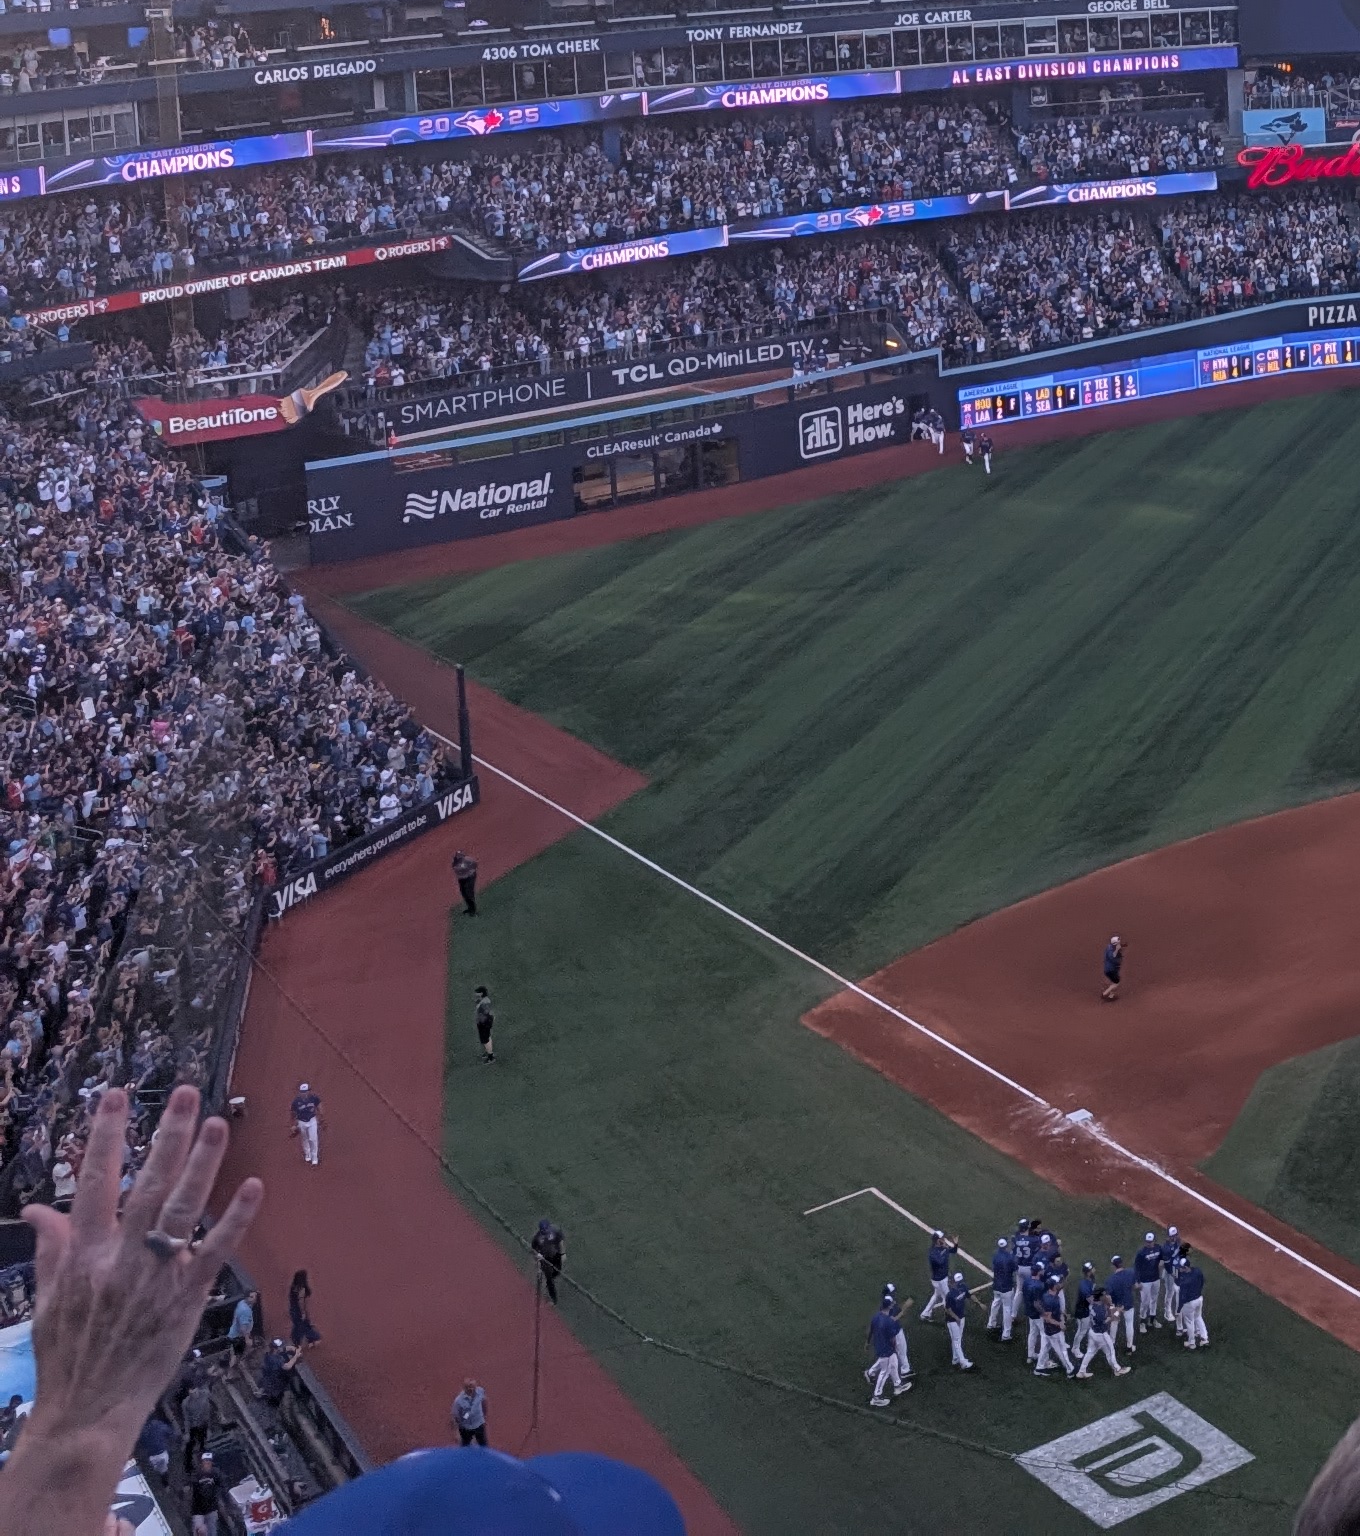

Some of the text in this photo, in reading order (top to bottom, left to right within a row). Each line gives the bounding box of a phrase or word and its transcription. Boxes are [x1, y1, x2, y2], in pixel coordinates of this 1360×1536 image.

[894, 10, 972, 27] JOE CARTER
[1087, 0, 1139, 14] GEORGE
[686, 21, 803, 43] TONY FERNANDEZ
[482, 38, 600, 61] 4306 TOM CHEEK
[254, 60, 377, 85] CARLOS DELGADO
[952, 53, 1180, 86] AL EAST DIVISION CHAMPIONS
[721, 83, 829, 109] CHAMPIONS
[122, 148, 234, 182] CHAMPIONS
[1067, 181, 1158, 203] CHAMPIONS
[581, 241, 669, 271] CHAMPIONS
[140, 242, 431, 305] PROUD OWNER OF CANADA'S TEAM ROGERS
[37, 303, 89, 325] ROGERS
[1308, 303, 1357, 327] PIZZA
[401, 377, 567, 425] SMARTPHONE
[612, 364, 664, 386] TCL
[745, 343, 784, 364] LED
[787, 339, 814, 357] TV
[1094, 378, 1108, 390] TEX
[1035, 400, 1050, 412] SEA
[1094, 390, 1109, 403] CLE
[169, 405, 278, 435] BeautiTone
[847, 396, 905, 424] Here's
[975, 412, 990, 424] LAA
[586, 426, 711, 459] CLEAResult Canada
[848, 422, 896, 447] How.
[479, 497, 548, 520] Car Rental
[273, 783, 473, 911] VISA everywhere VISA
[1073, 1410, 1203, 1498] TD
